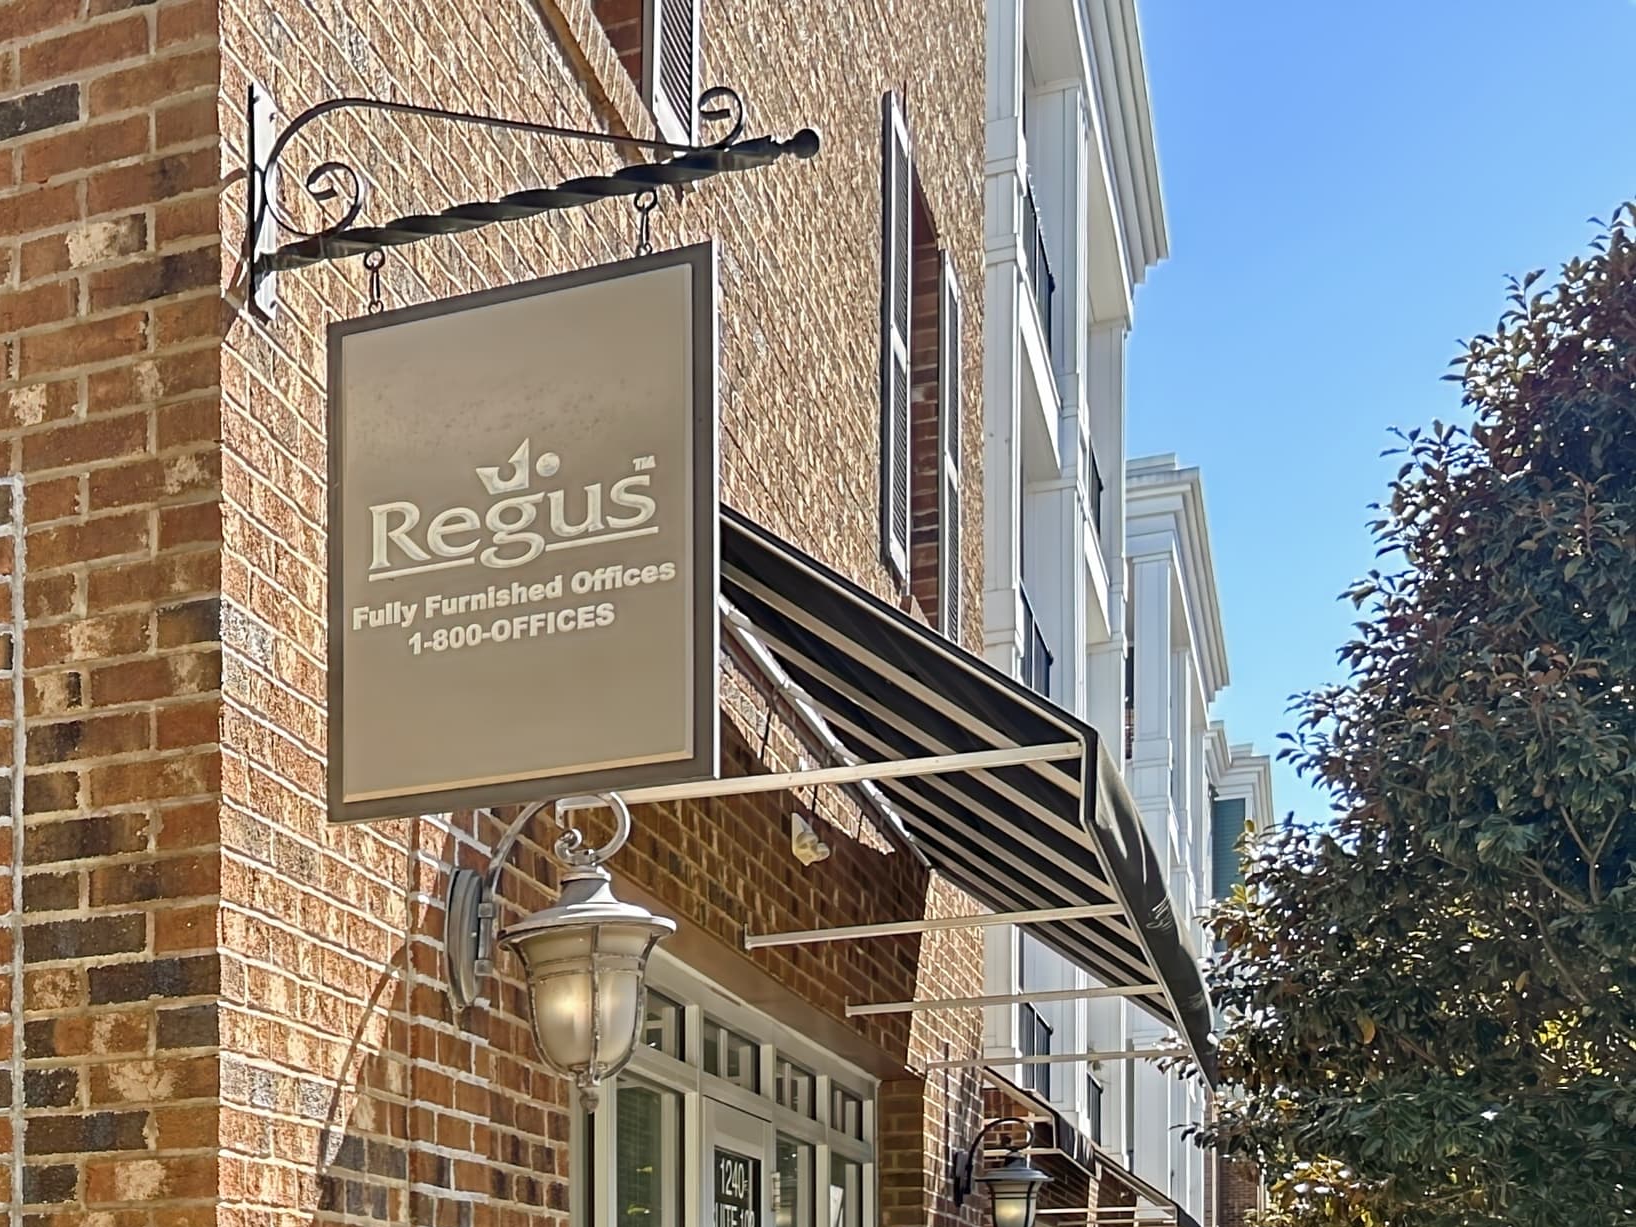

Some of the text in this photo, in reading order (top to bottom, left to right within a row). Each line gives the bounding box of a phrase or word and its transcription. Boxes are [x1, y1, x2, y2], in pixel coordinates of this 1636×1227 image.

[368, 474, 657, 569] Regus
[352, 561, 677, 631] Fully Furnished Offices
[408, 603, 616, 656] 1-800-OFFICES
[720, 1157, 745, 1200] 1240
